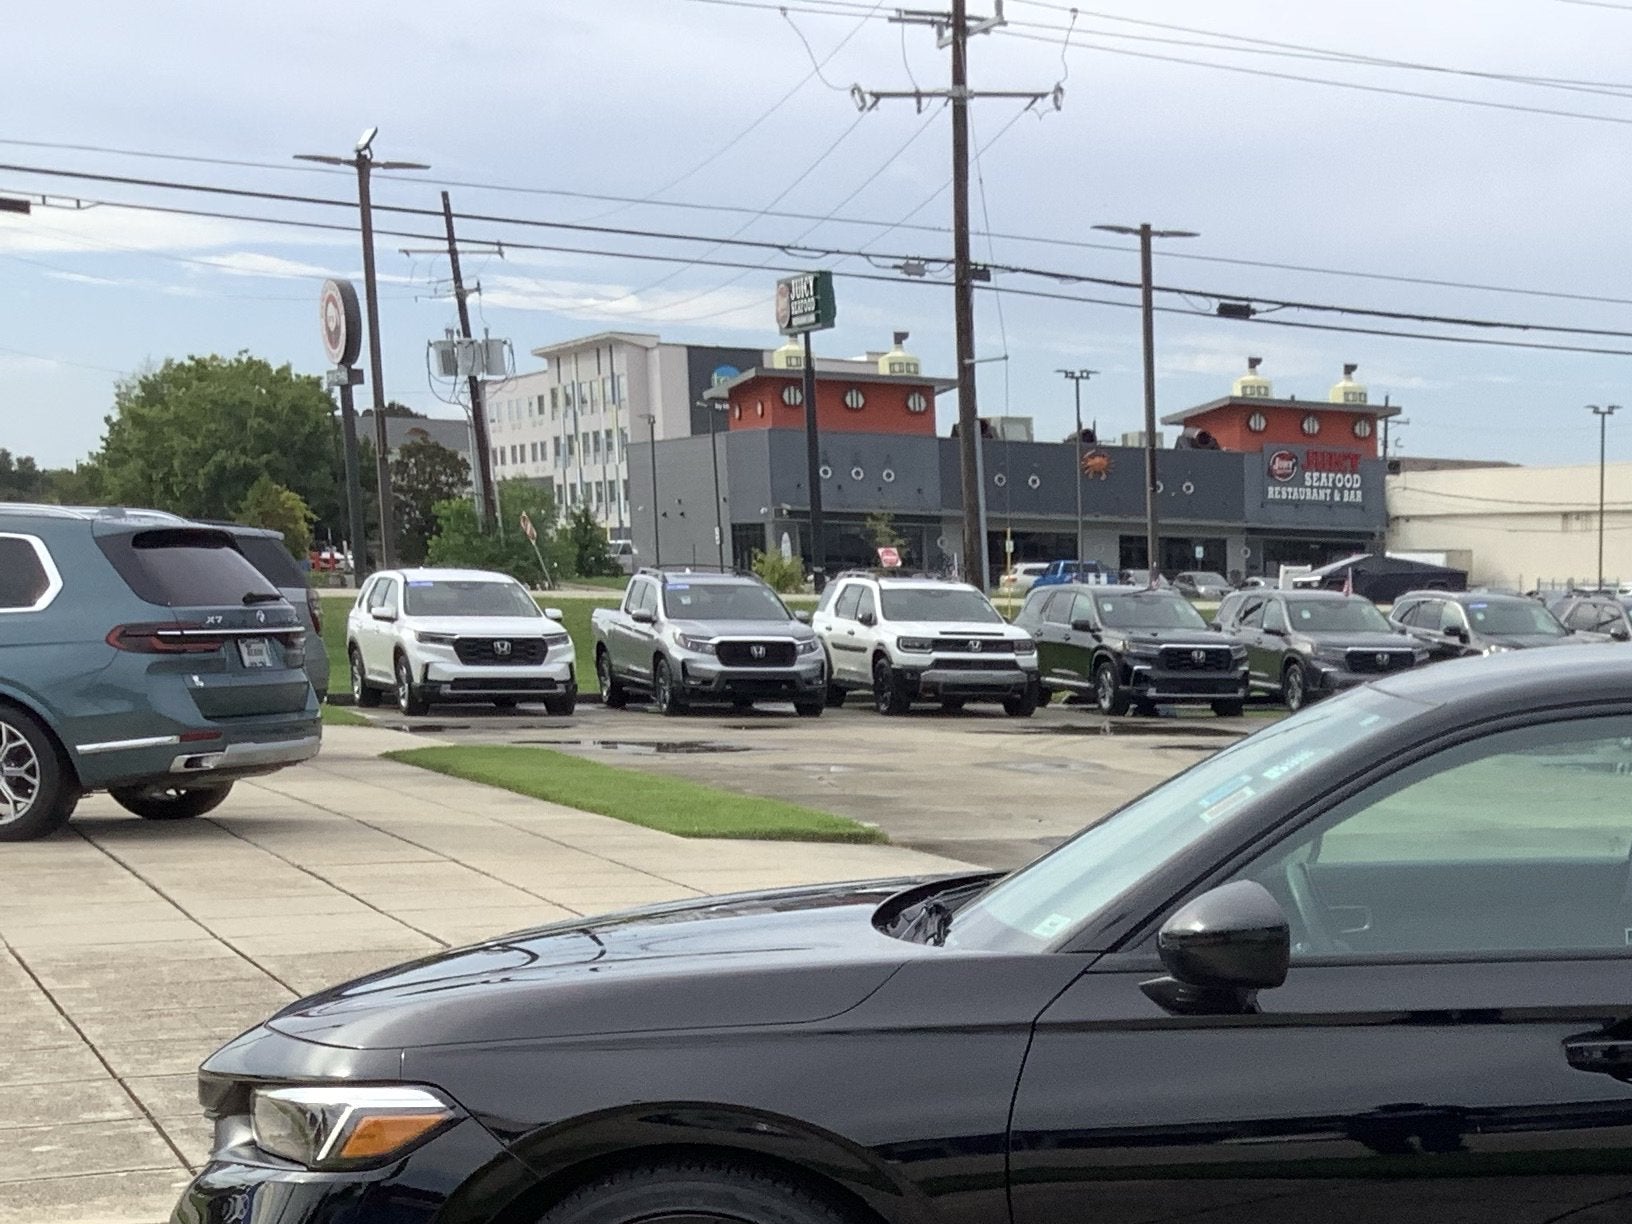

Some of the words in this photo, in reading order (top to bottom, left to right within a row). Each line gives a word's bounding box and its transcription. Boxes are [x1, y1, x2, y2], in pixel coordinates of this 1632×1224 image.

[1304, 472, 1362, 488] SEAFOOD
[1267, 486, 1331, 501] RESTAURANT
[1333, 489, 1341, 501] &
[1343, 489, 1362, 502] BAR
[206, 615, 224, 625] X7
